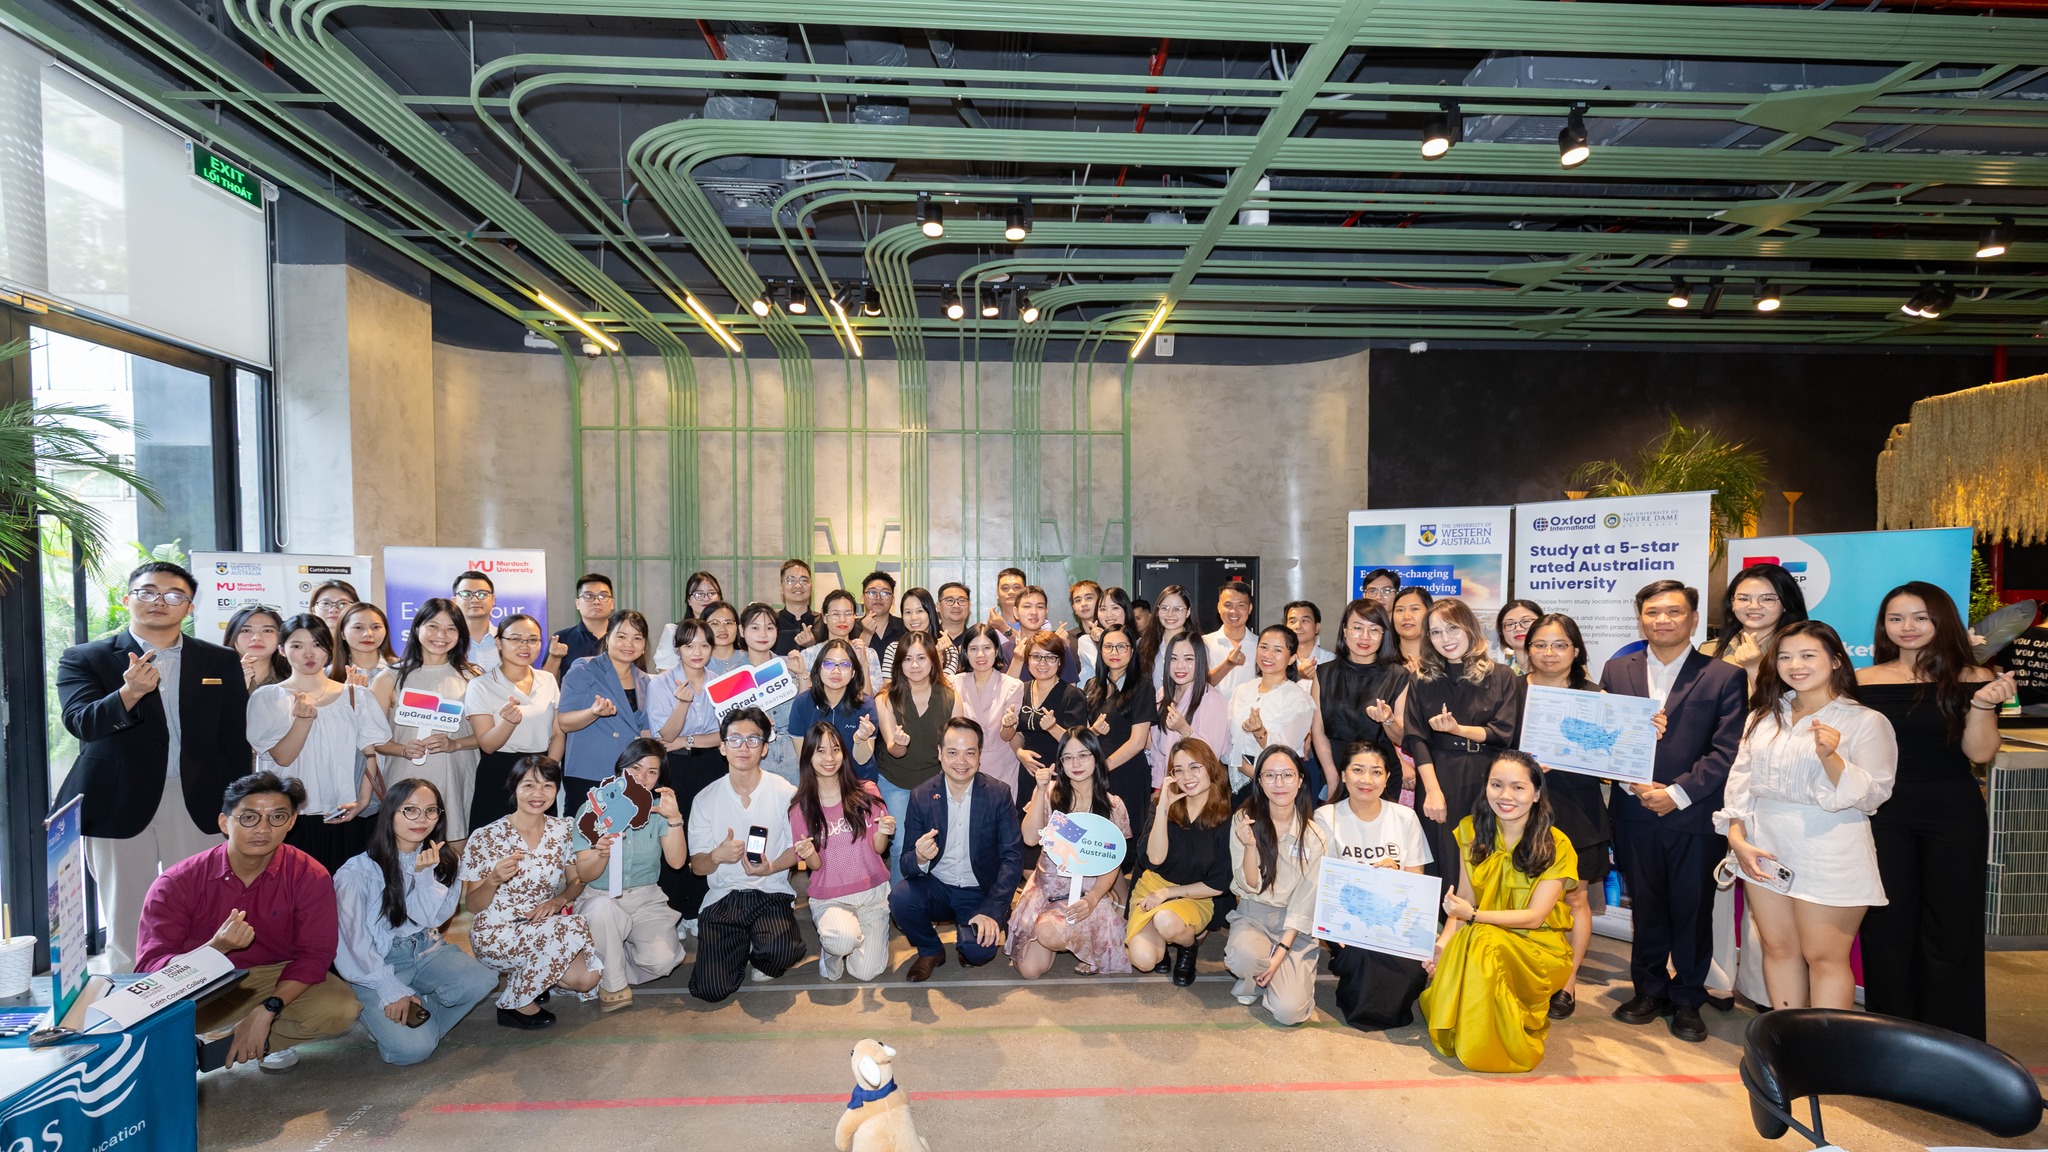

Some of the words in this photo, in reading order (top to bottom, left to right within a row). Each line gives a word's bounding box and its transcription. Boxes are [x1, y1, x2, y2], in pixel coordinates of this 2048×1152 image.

[211, 156, 245, 183] EXIT
[221, 177, 252, 200] THOÁT
[1550, 514, 1596, 526] Oxford
[1442, 528, 1492, 537] WESTERN
[1550, 524, 1596, 532] International
[1441, 537, 1491, 546] AUSTRALIA
[1530, 544, 1579, 558] Study
[1582, 543, 1600, 554] at
[1604, 544, 1615, 554] a
[1620, 541, 1680, 553] 5-star
[468, 560, 494, 572] MU
[1530, 561, 1574, 573] rated
[1578, 557, 1674, 572] Australian
[216, 583, 234, 591] MU
[1530, 577, 1617, 592] university
[490, 606, 524, 618] our
[766, 678, 789, 694] GSP
[766, 688, 795, 706] PARTNERS
[399, 710, 432, 720] upGrad
[440, 716, 460, 724] GSP
[1081, 838, 1092, 846] Go
[1080, 848, 1116, 860] Australia
[1342, 842, 1400, 859] ABCDE
[161, 964, 181, 975] EDITH
[167, 965, 191, 978] COWAN
[174, 968, 199, 982] COLLEGE
[127, 978, 158, 995] ECU
[150, 998, 168, 1009] Edith
[166, 987, 188, 1001] Cowan
[187, 976, 208, 991] College
